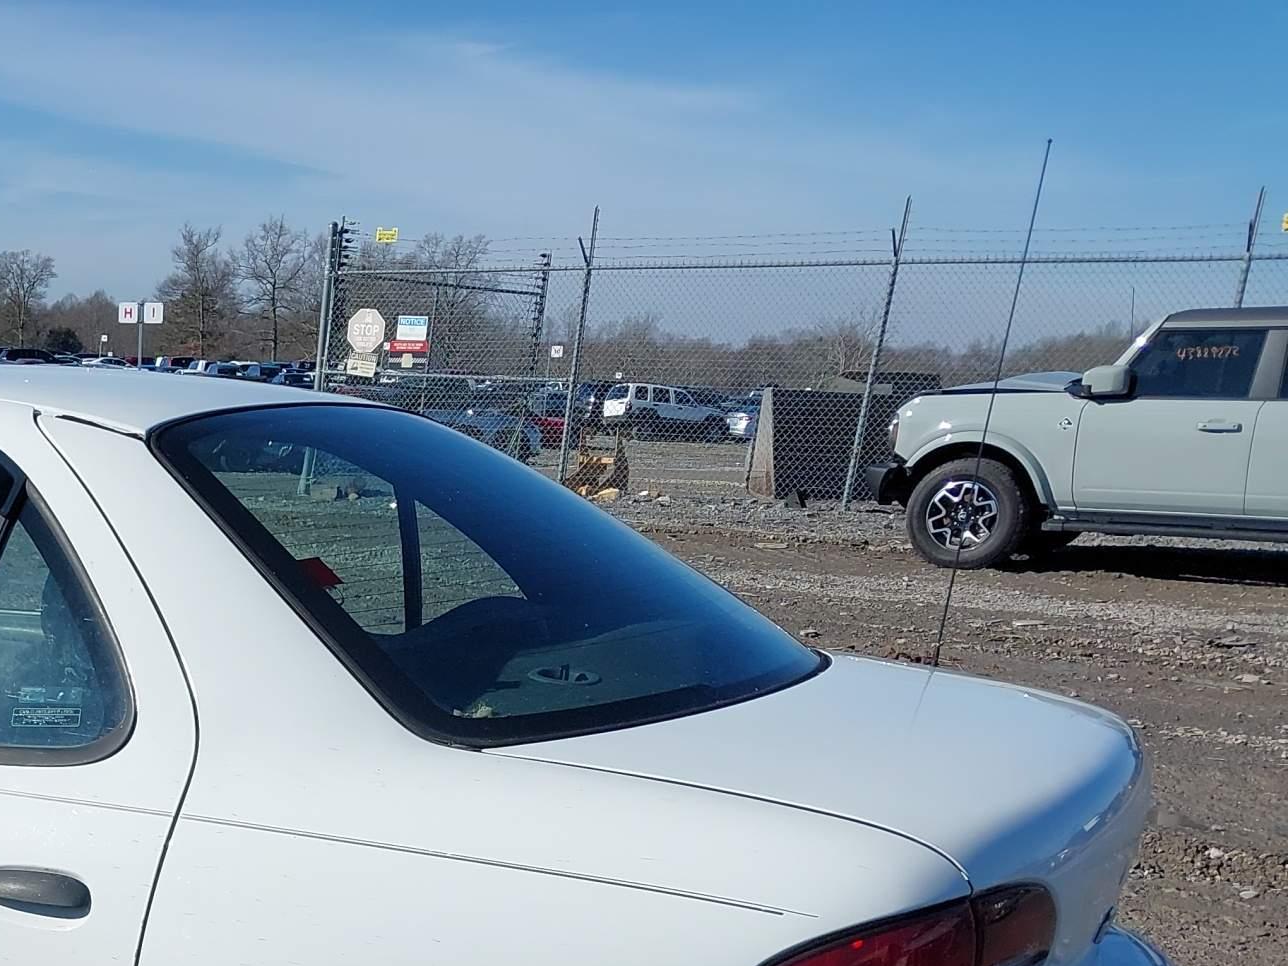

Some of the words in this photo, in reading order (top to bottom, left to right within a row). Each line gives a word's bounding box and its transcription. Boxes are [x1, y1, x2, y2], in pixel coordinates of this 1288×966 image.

[124, 307, 133, 319] H
[353, 324, 379, 335] STOP
[351, 353, 376, 363] CAUTION
